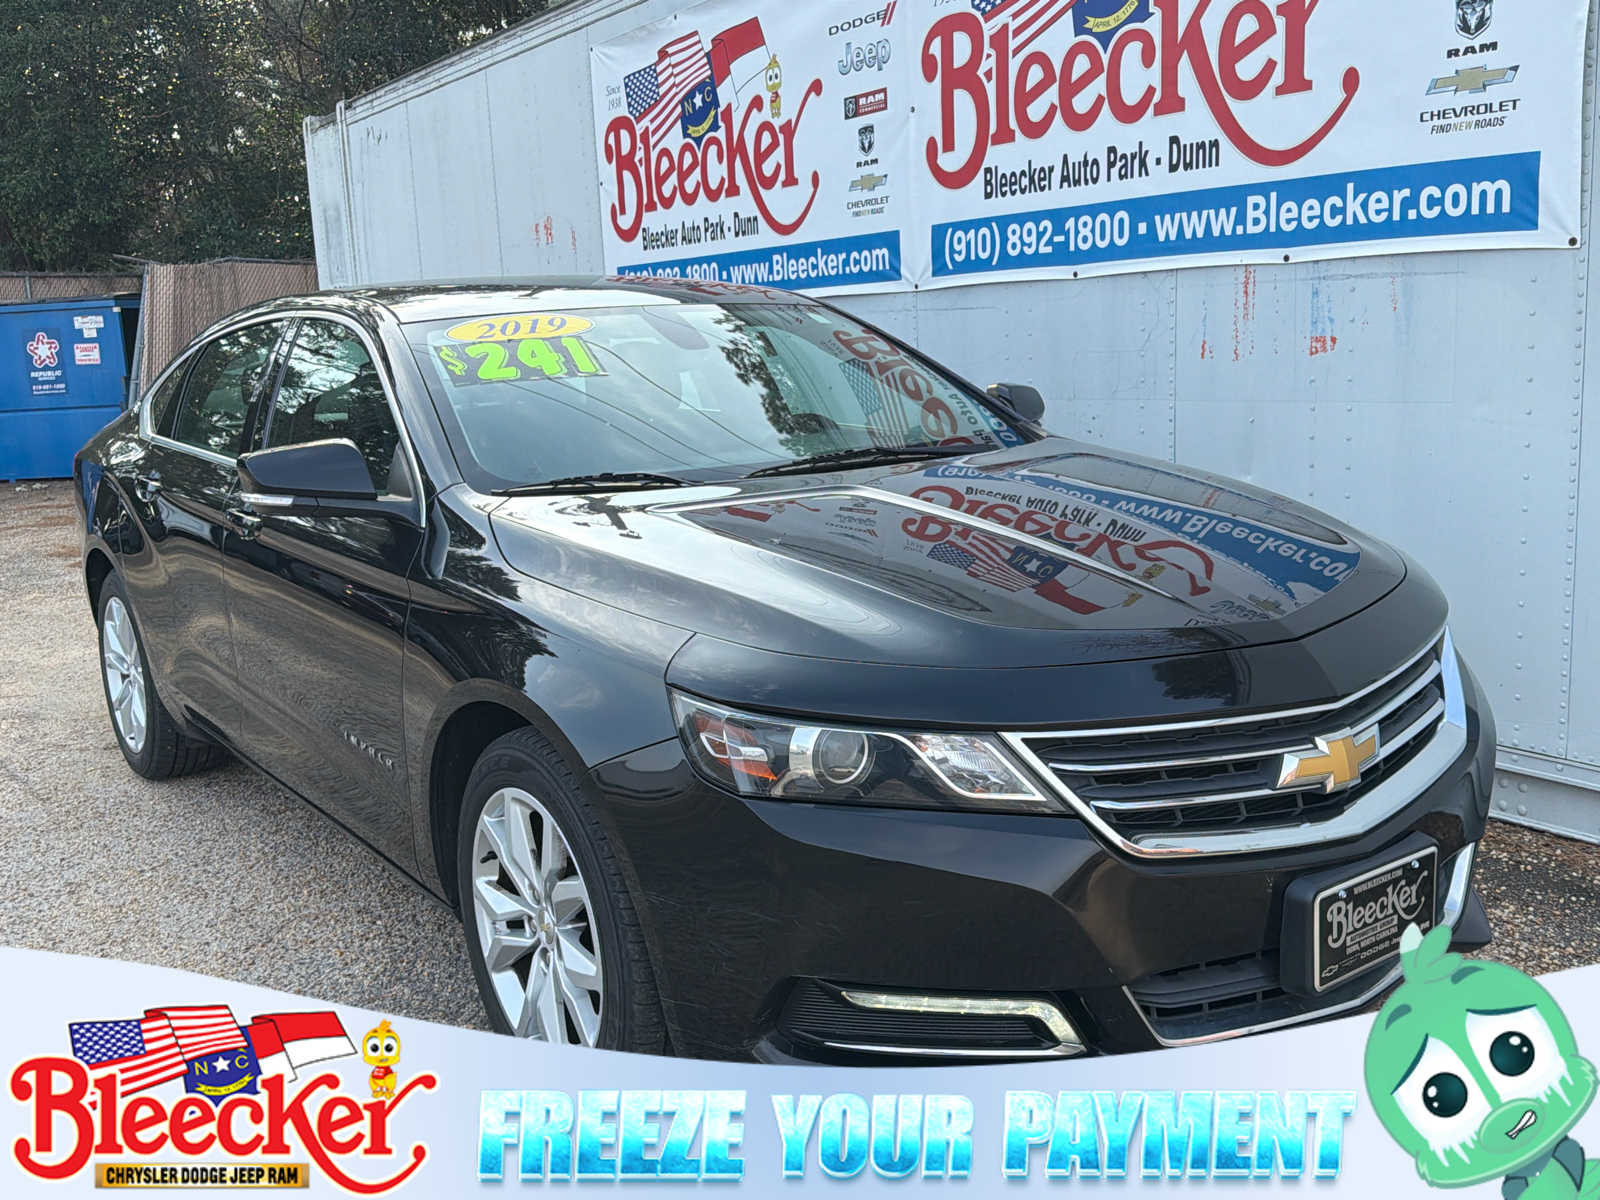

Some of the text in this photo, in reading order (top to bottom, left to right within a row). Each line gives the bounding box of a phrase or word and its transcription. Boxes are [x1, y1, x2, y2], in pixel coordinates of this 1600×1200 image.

[828, 9, 888, 36] DODGE
[838, 38, 891, 75] Jeep
[1446, 41, 1498, 59] RAM
[859, 92, 885, 106] RAM
[1419, 99, 1520, 123] CHEVROLET
[604, 78, 823, 242] Bleecker
[856, 158, 879, 168] RAM
[984, 135, 1220, 200] Bleecker Auto Park Dunn
[847, 195, 890, 210] CHEVROLET
[642, 211, 759, 250] Bleecker Auto Park Dunn
[944, 179, 1511, 270] (910) 892-1800 www.Bleecker.com
[730, 248, 890, 284] www.Bleecker.com
[477, 317, 568, 340] 2019
[1326, 870, 1428, 948] Bleecker
[1360, 940, 1390, 959] DODGE
